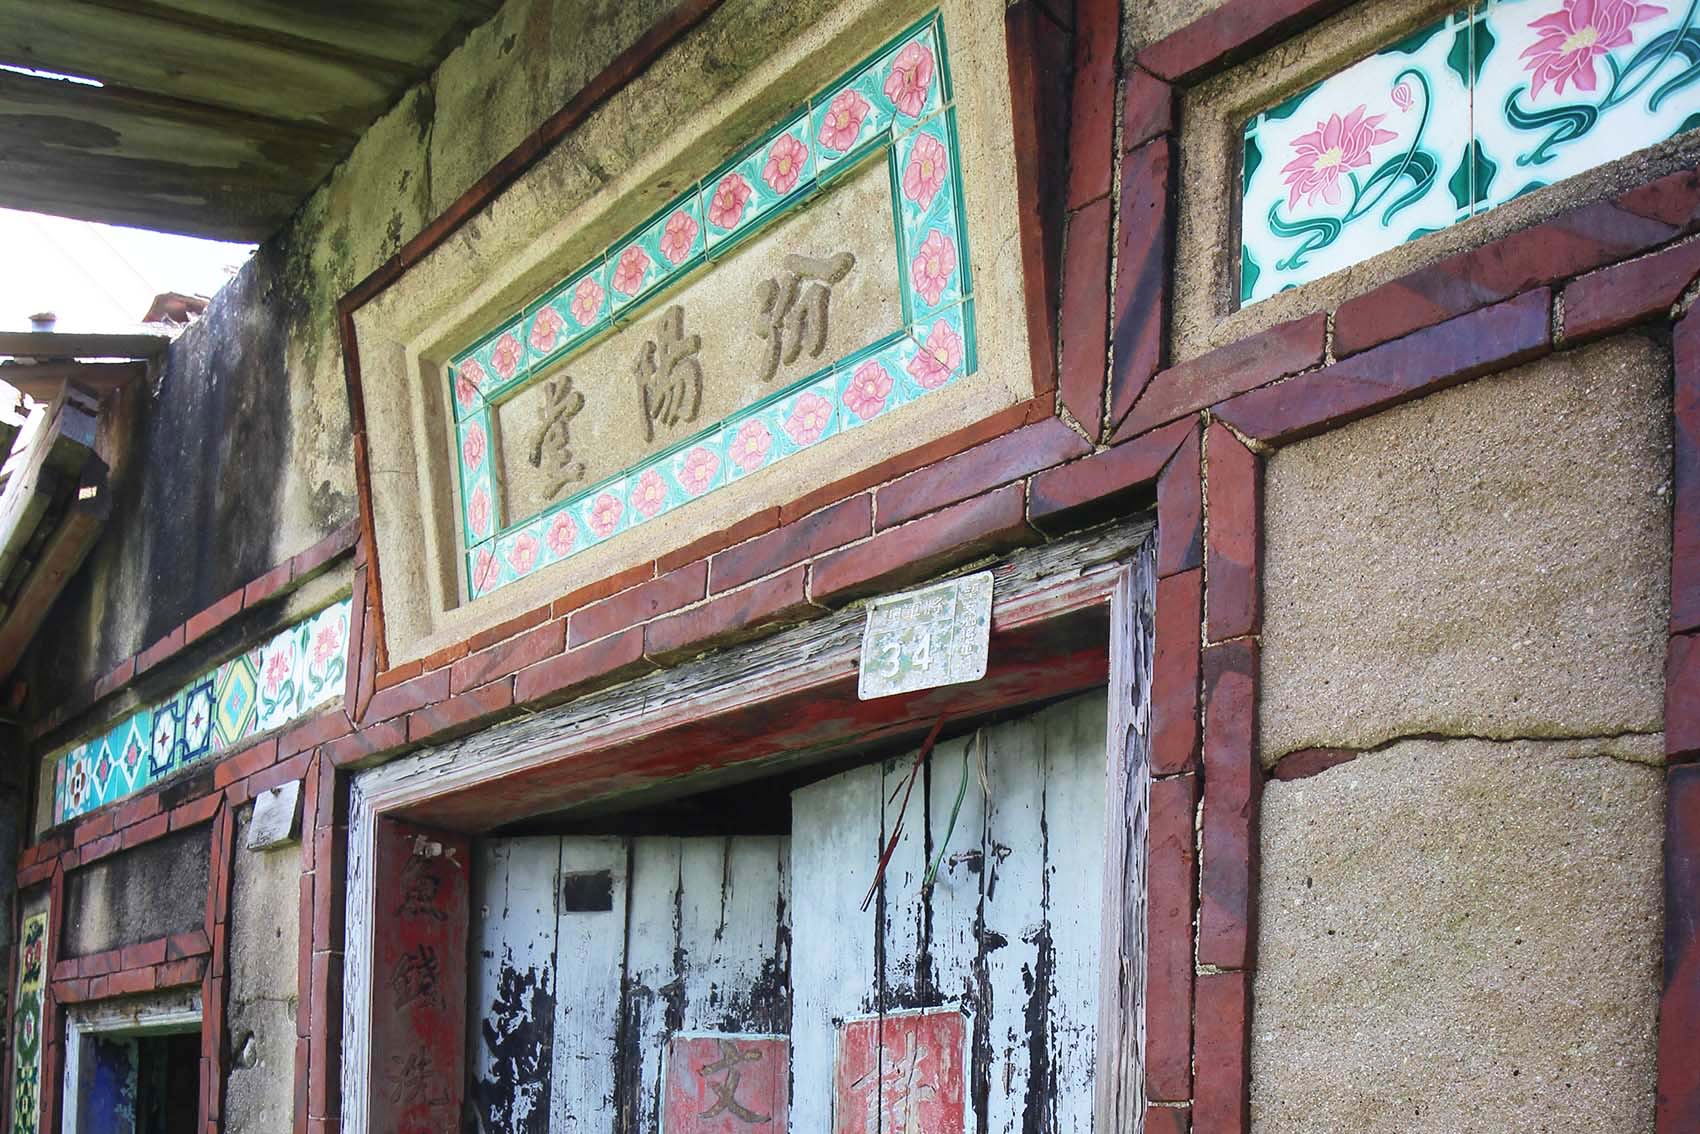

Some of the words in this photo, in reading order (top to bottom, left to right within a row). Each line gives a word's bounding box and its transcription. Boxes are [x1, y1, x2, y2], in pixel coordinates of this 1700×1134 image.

[527, 251, 856, 500] 汾陽堂
[880, 631, 934, 679] 34
